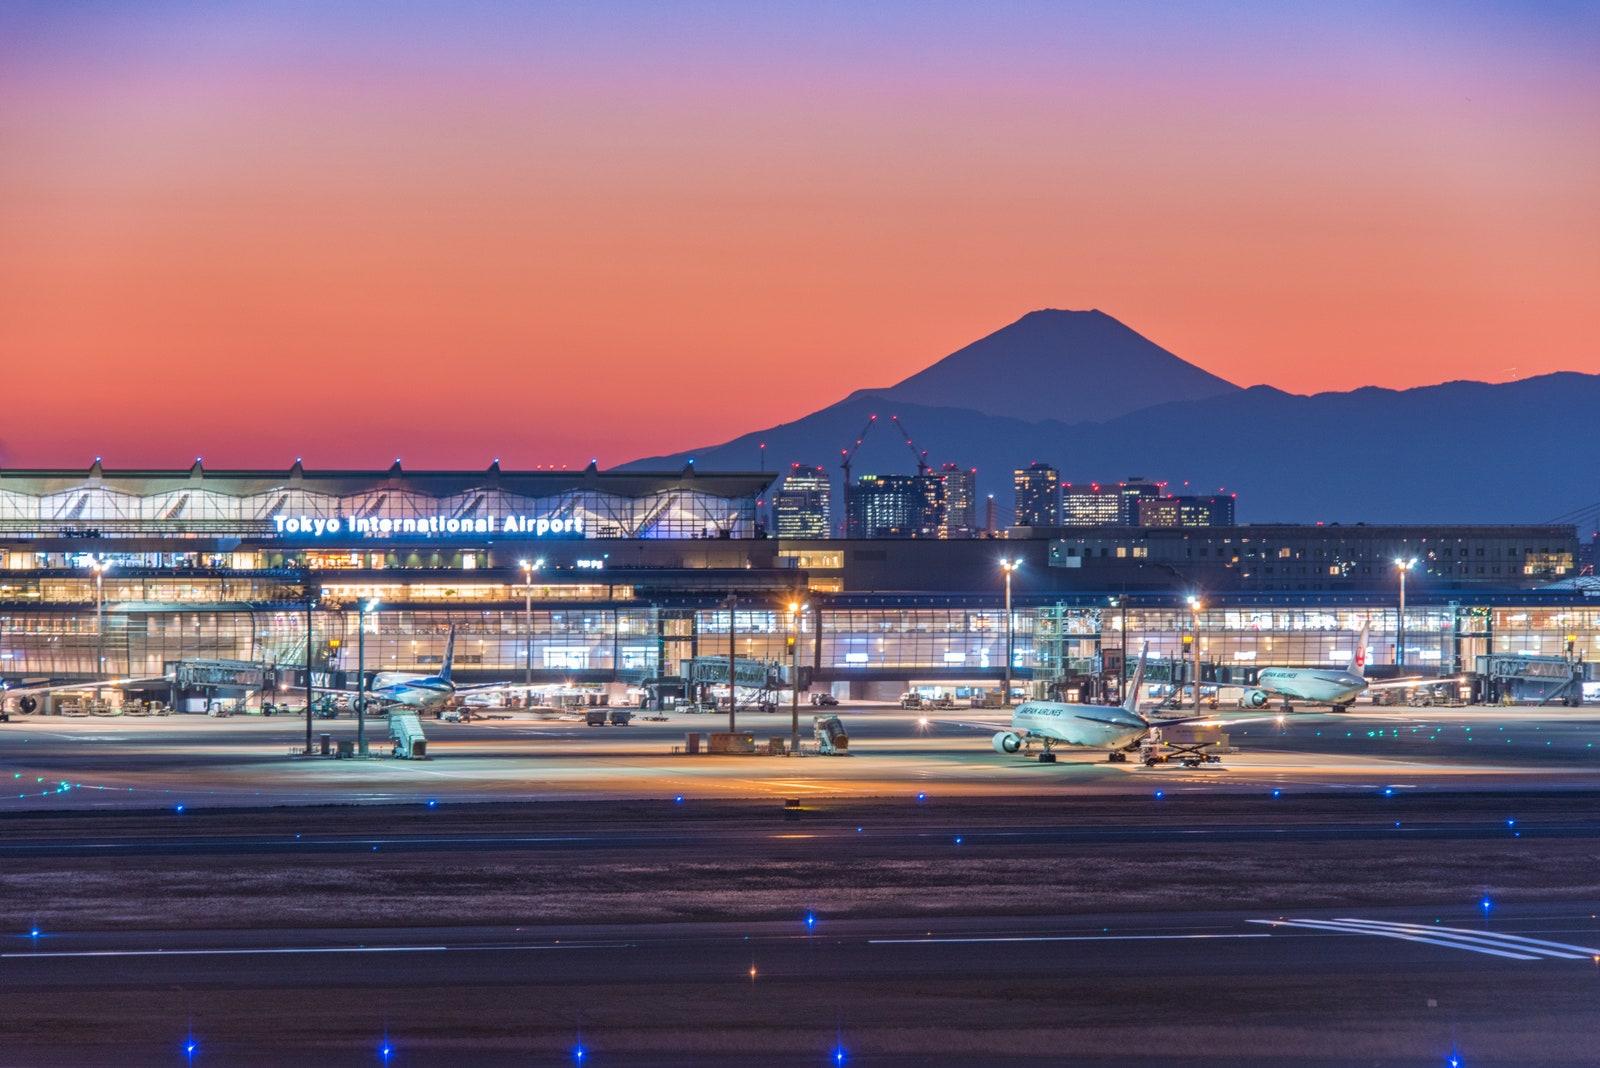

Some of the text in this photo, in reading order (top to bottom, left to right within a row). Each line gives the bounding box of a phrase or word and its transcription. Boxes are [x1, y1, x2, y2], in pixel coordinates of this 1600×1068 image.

[273, 515, 583, 536] Tokyo International Airport
[1020, 706, 1064, 717] JAPAN AIRLINES
